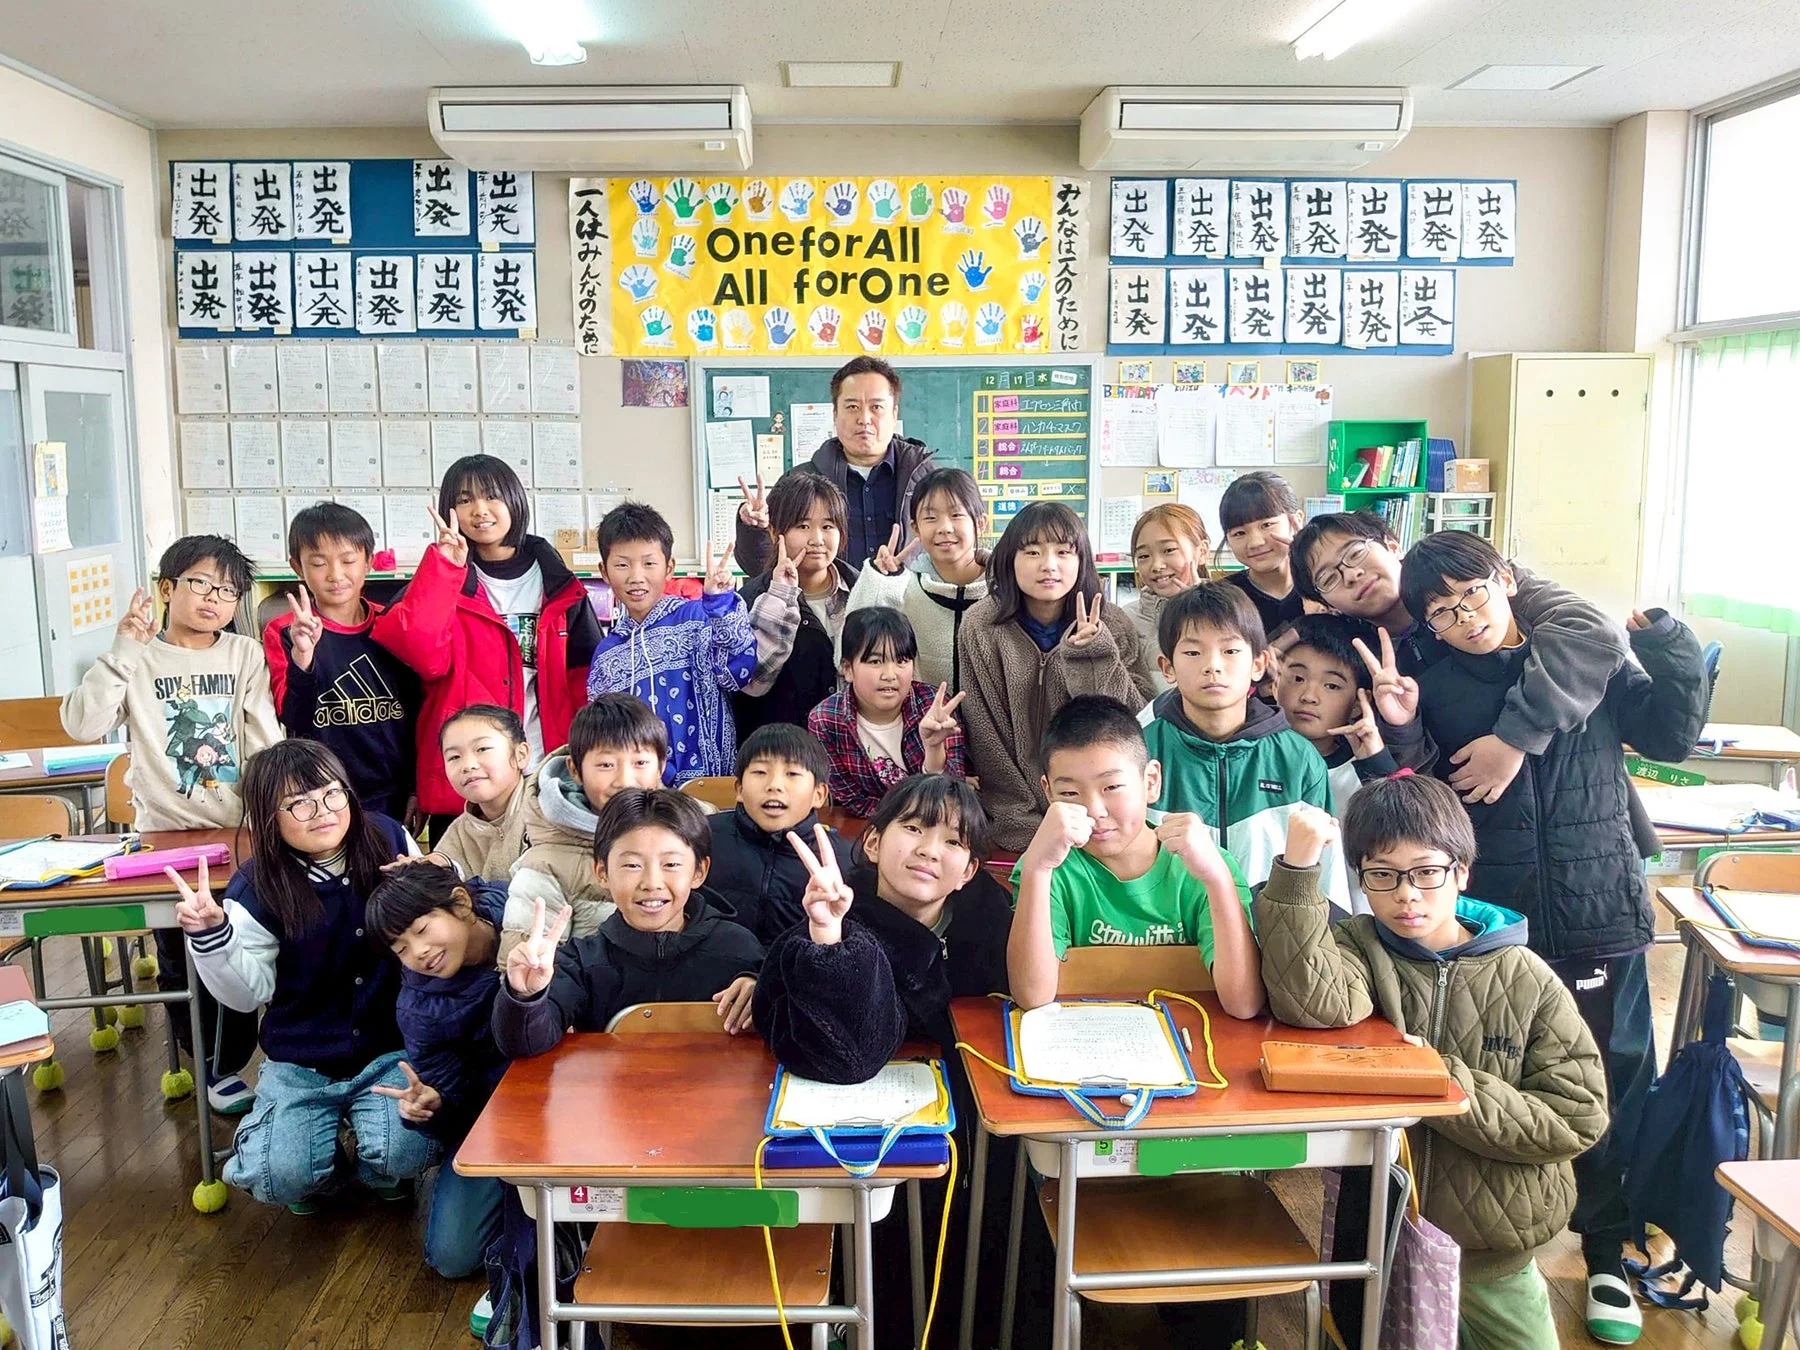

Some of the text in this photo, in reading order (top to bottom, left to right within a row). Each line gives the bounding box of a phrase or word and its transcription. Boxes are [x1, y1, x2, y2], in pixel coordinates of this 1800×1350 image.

[188, 168, 223, 236] 出発
[249, 168, 287, 236] 出発
[308, 165, 346, 234] 出発
[421, 164, 461, 227] 出発
[485, 171, 519, 235] 出発
[1121, 188, 1154, 253] 出発
[1188, 186, 1219, 253] 出発
[1250, 187, 1280, 252] 出発
[1302, 187, 1340, 254] 出発
[1355, 186, 1399, 253] 出発
[1422, 186, 1458, 251] 出発
[1477, 187, 1509, 253] 出発
[190, 259, 227, 319] 出発
[247, 260, 286, 325] 出発
[368, 259, 404, 326] 出発
[428, 256, 466, 323] 出発
[491, 258, 527, 323] 出発
[574, 188, 609, 355] 一人はみんなのために
[713, 268, 768, 306] All
[1055, 183, 1081, 351] みんなは一人のために
[1126, 275, 1158, 337] 出発
[1182, 278, 1218, 341] 出発
[1242, 275, 1274, 337] 出発
[1297, 272, 1336, 335] 出発
[1359, 278, 1392, 342] 出発
[1103, 384, 1158, 400] BIRTHDAY
[313, 699, 405, 728] adidas
[574, 1186, 584, 1198] 4
